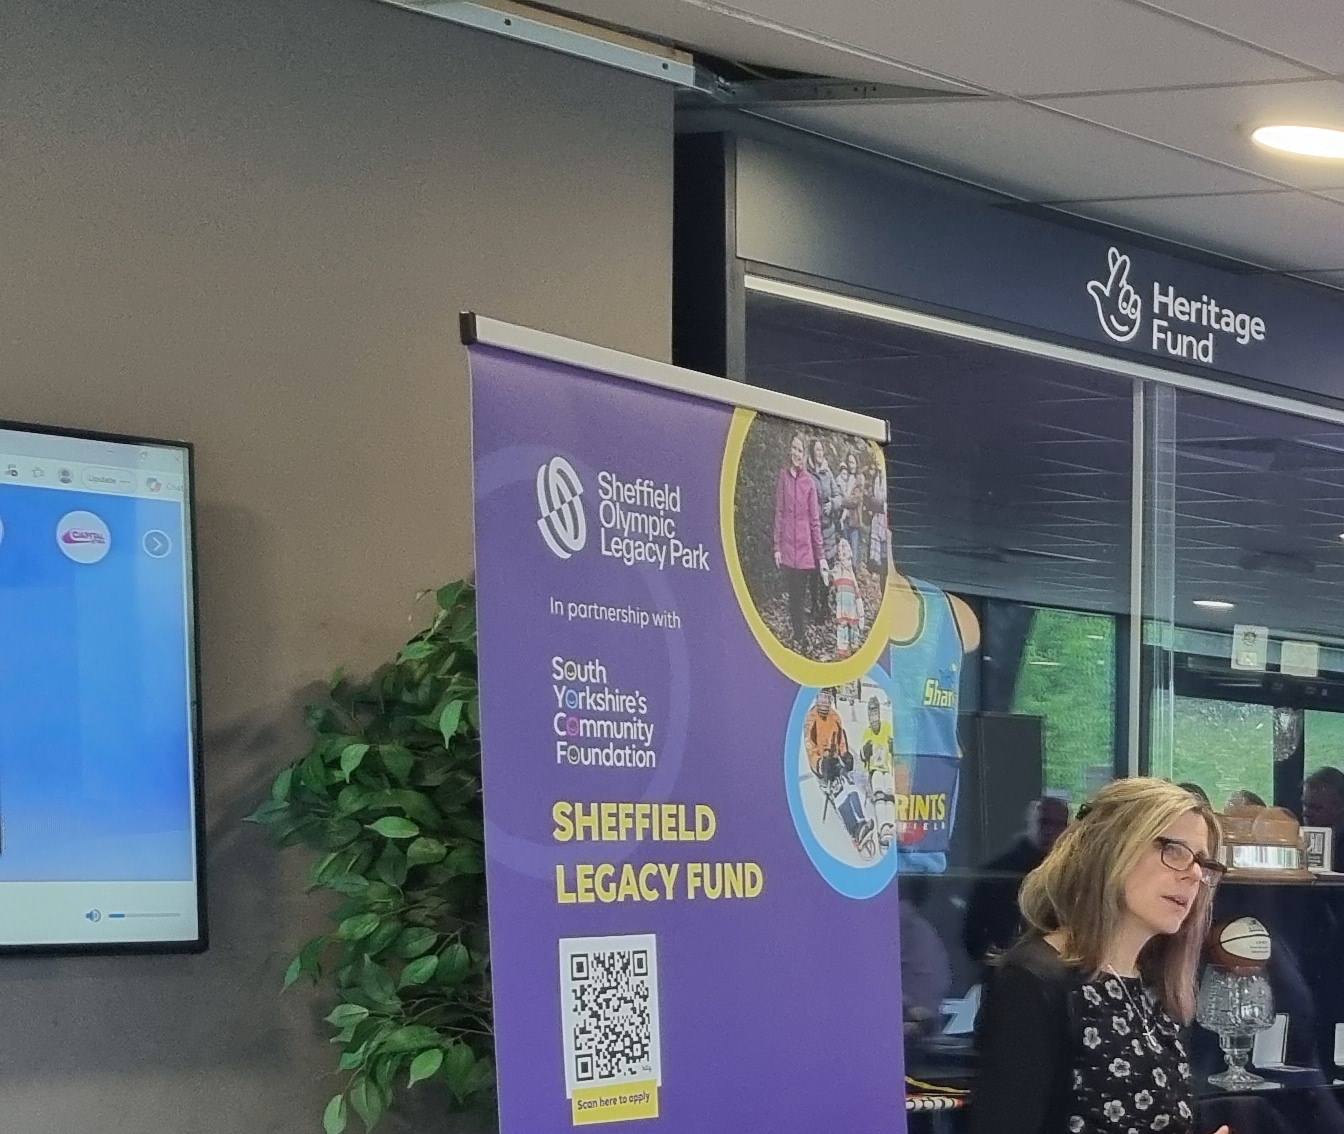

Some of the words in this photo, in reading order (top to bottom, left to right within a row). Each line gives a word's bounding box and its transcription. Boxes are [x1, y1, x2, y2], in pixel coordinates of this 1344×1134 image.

[1153, 281, 1266, 345] Heritage
[1152, 318, 1214, 364] Fund
[598, 471, 681, 513] Sheffield
[600, 501, 676, 541] Olympic
[601, 527, 667, 570] Legacy
[670, 538, 711, 572] Park
[550, 596, 564, 615] In
[568, 600, 650, 629] partnership
[652, 610, 681, 629] with
[552, 655, 607, 684] South
[553, 684, 648, 715] Yorkshire's
[553, 713, 654, 747] Community
[556, 740, 656, 769] Foundation
[552, 800, 717, 843] SHEFFIELD
[896, 793, 946, 821] RINTS
[555, 863, 679, 905] LEGACY
[686, 860, 764, 899] FUND
[577, 1099, 598, 1110] Scan
[599, 1096, 618, 1107] here
[619, 1095, 628, 1105] to
[628, 1090, 651, 1105] apply
